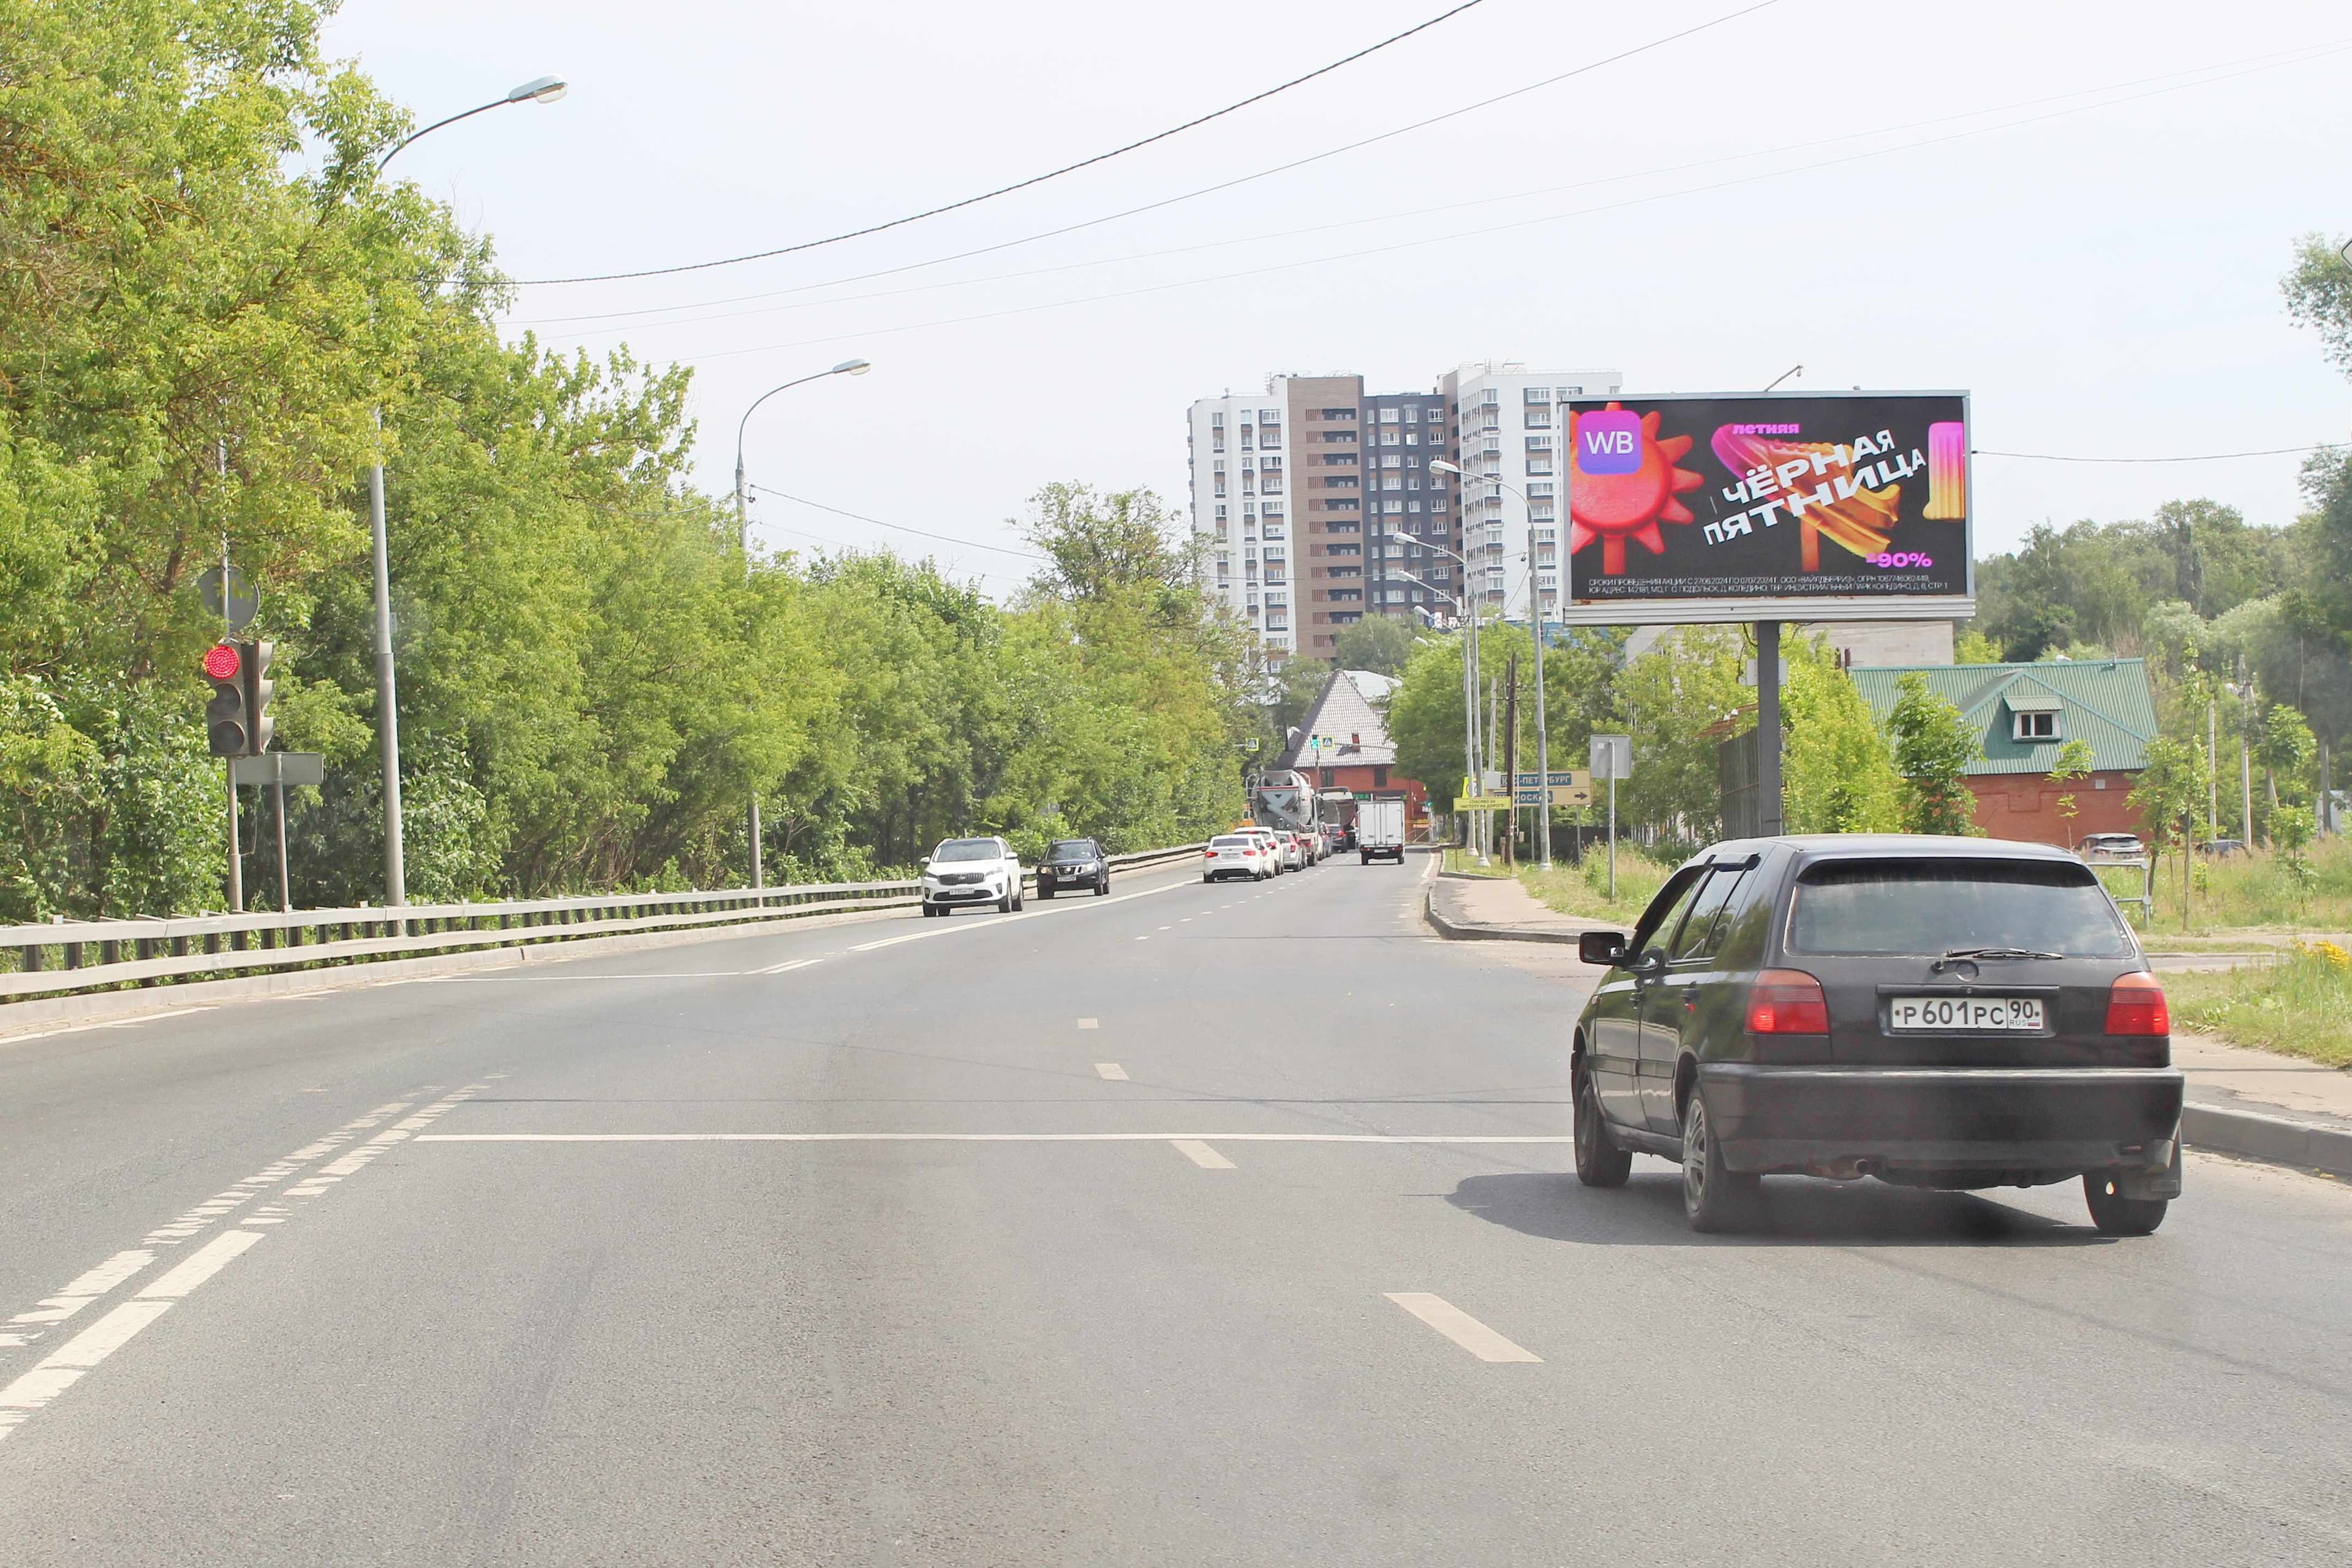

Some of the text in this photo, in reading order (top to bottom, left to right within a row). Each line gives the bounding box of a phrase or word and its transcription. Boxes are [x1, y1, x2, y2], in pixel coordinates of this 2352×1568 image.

[1585, 431, 1634, 454] WB
[1722, 429, 1895, 503] ЧЁРНАЯ
[1703, 448, 1927, 546] ПЯТНИЦА
[1904, 1000, 2034, 1025] Р601РС 90
